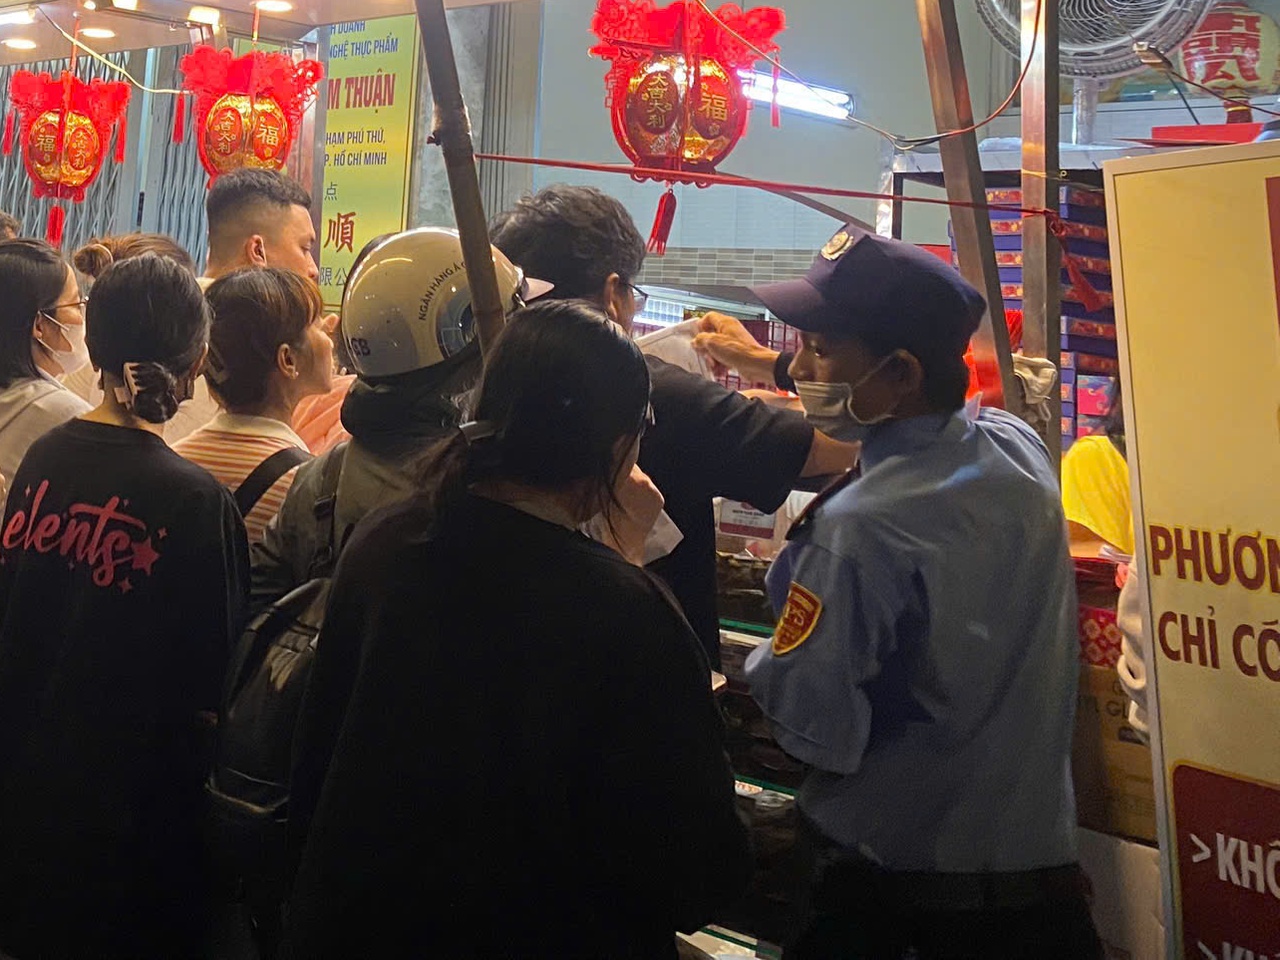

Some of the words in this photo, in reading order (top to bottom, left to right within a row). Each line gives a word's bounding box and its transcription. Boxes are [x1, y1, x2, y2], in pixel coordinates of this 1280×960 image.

[351, 40, 372, 58] THỰC
[373, 31, 399, 55] PHẨM
[345, 67, 396, 114] THUẬN
[697, 92, 729, 122] 福
[35, 133, 57, 152] 福
[256, 123, 280, 147] 福
[325, 132, 345, 148] HẠM
[347, 128, 365, 143] PHÚ
[347, 149, 363, 166] CHÍ
[364, 151, 387, 166] MINH
[324, 181, 338, 201] 点
[323, 211, 357, 254] 順
[1158, 605, 1220, 670] CHỈ
